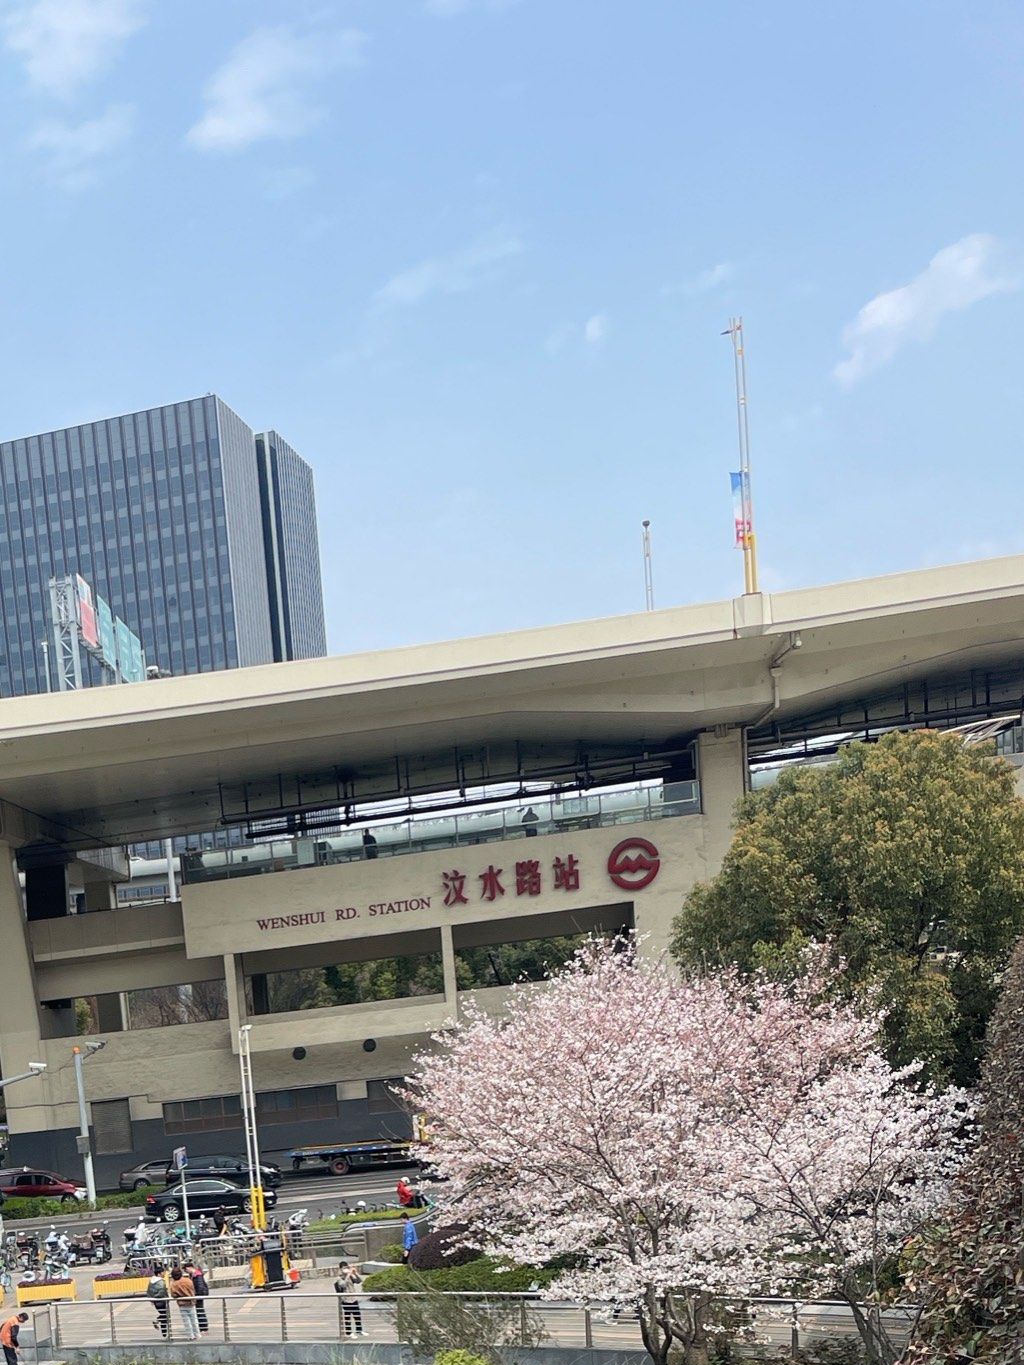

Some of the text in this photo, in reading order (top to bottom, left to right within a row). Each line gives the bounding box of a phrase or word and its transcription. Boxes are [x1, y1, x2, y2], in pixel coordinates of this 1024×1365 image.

[442, 853, 580, 907] 汶水路站
[256, 896, 432, 931] WENSHUI RD. STATION
